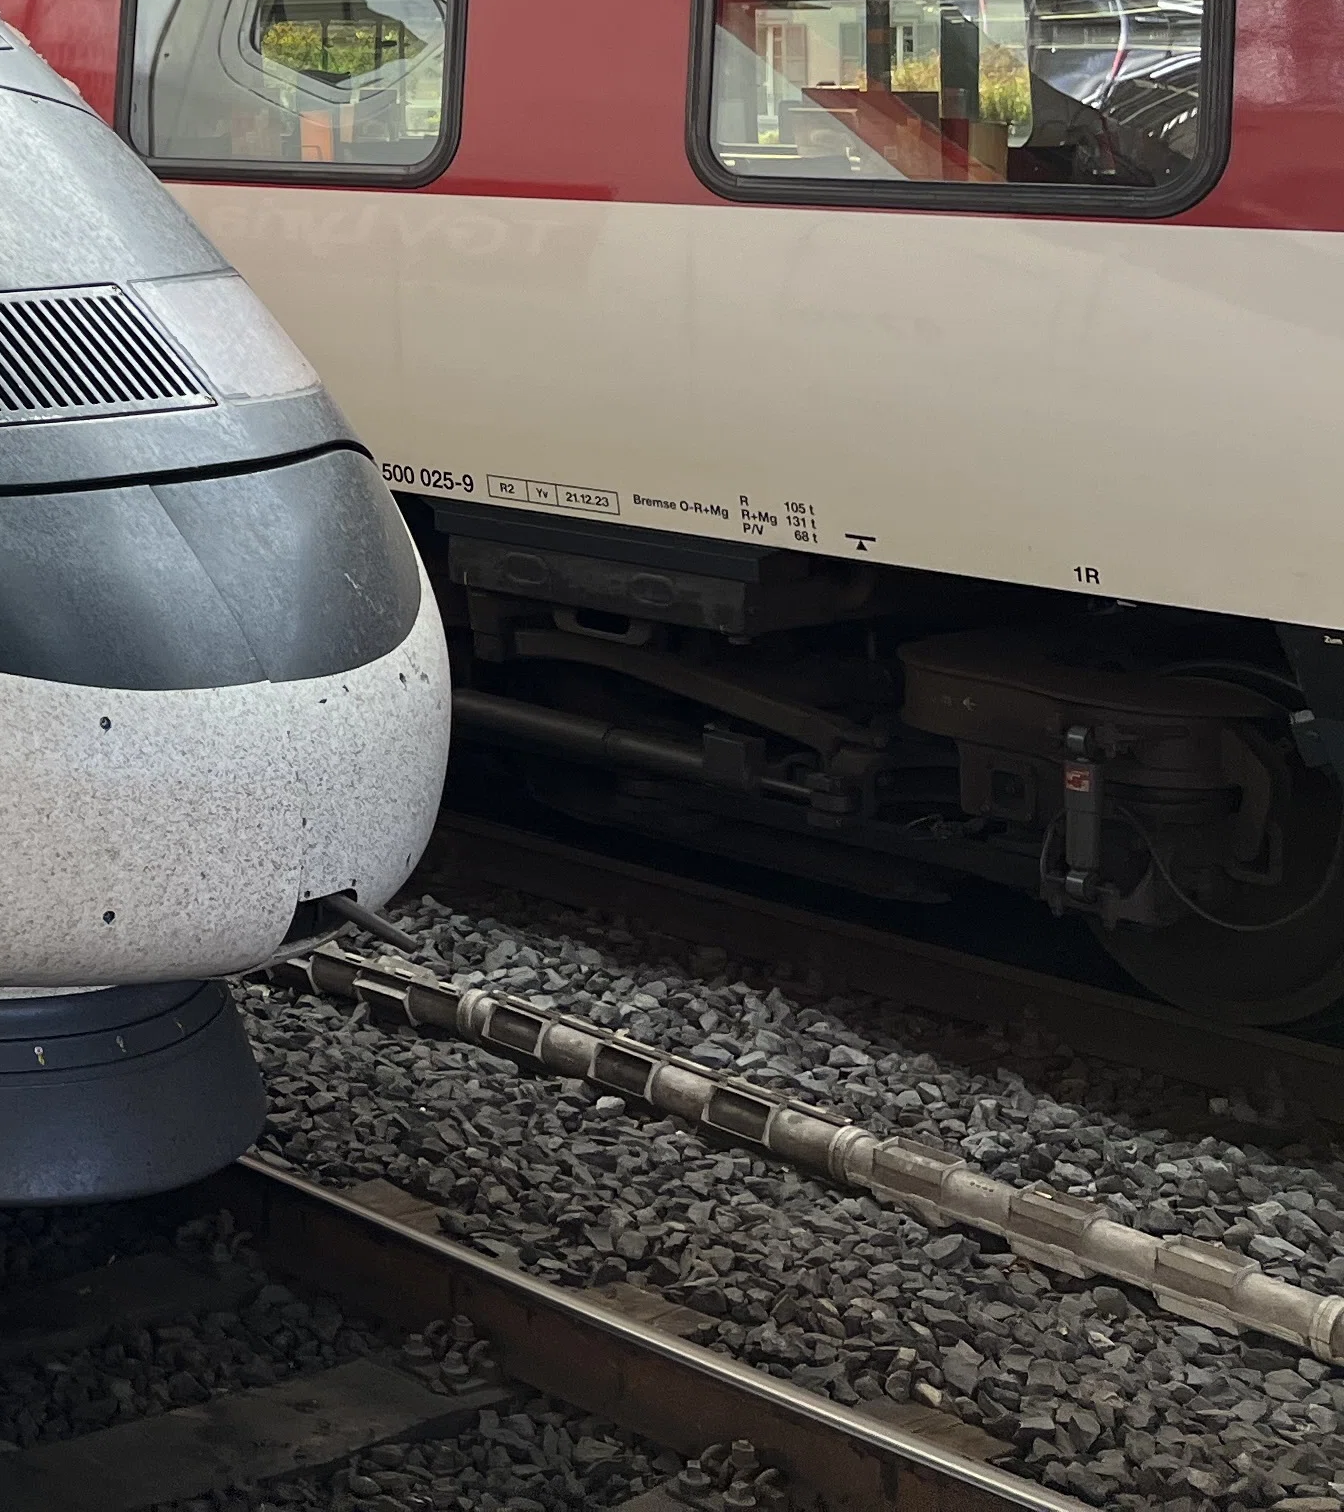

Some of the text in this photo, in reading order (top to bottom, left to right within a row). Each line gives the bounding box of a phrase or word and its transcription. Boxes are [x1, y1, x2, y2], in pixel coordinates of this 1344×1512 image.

[382, 463, 474, 493] 500 025-9
[499, 482, 515, 494] R2
[565, 491, 610, 507] 21.12.23
[633, 493, 729, 520] Bremse O-R+Mg
[739, 495, 815, 516] R 105 t
[741, 509, 817, 530] R+Mg 131 t
[743, 523, 818, 544] P/V 68 t
[1073, 566, 1101, 585] 1R
